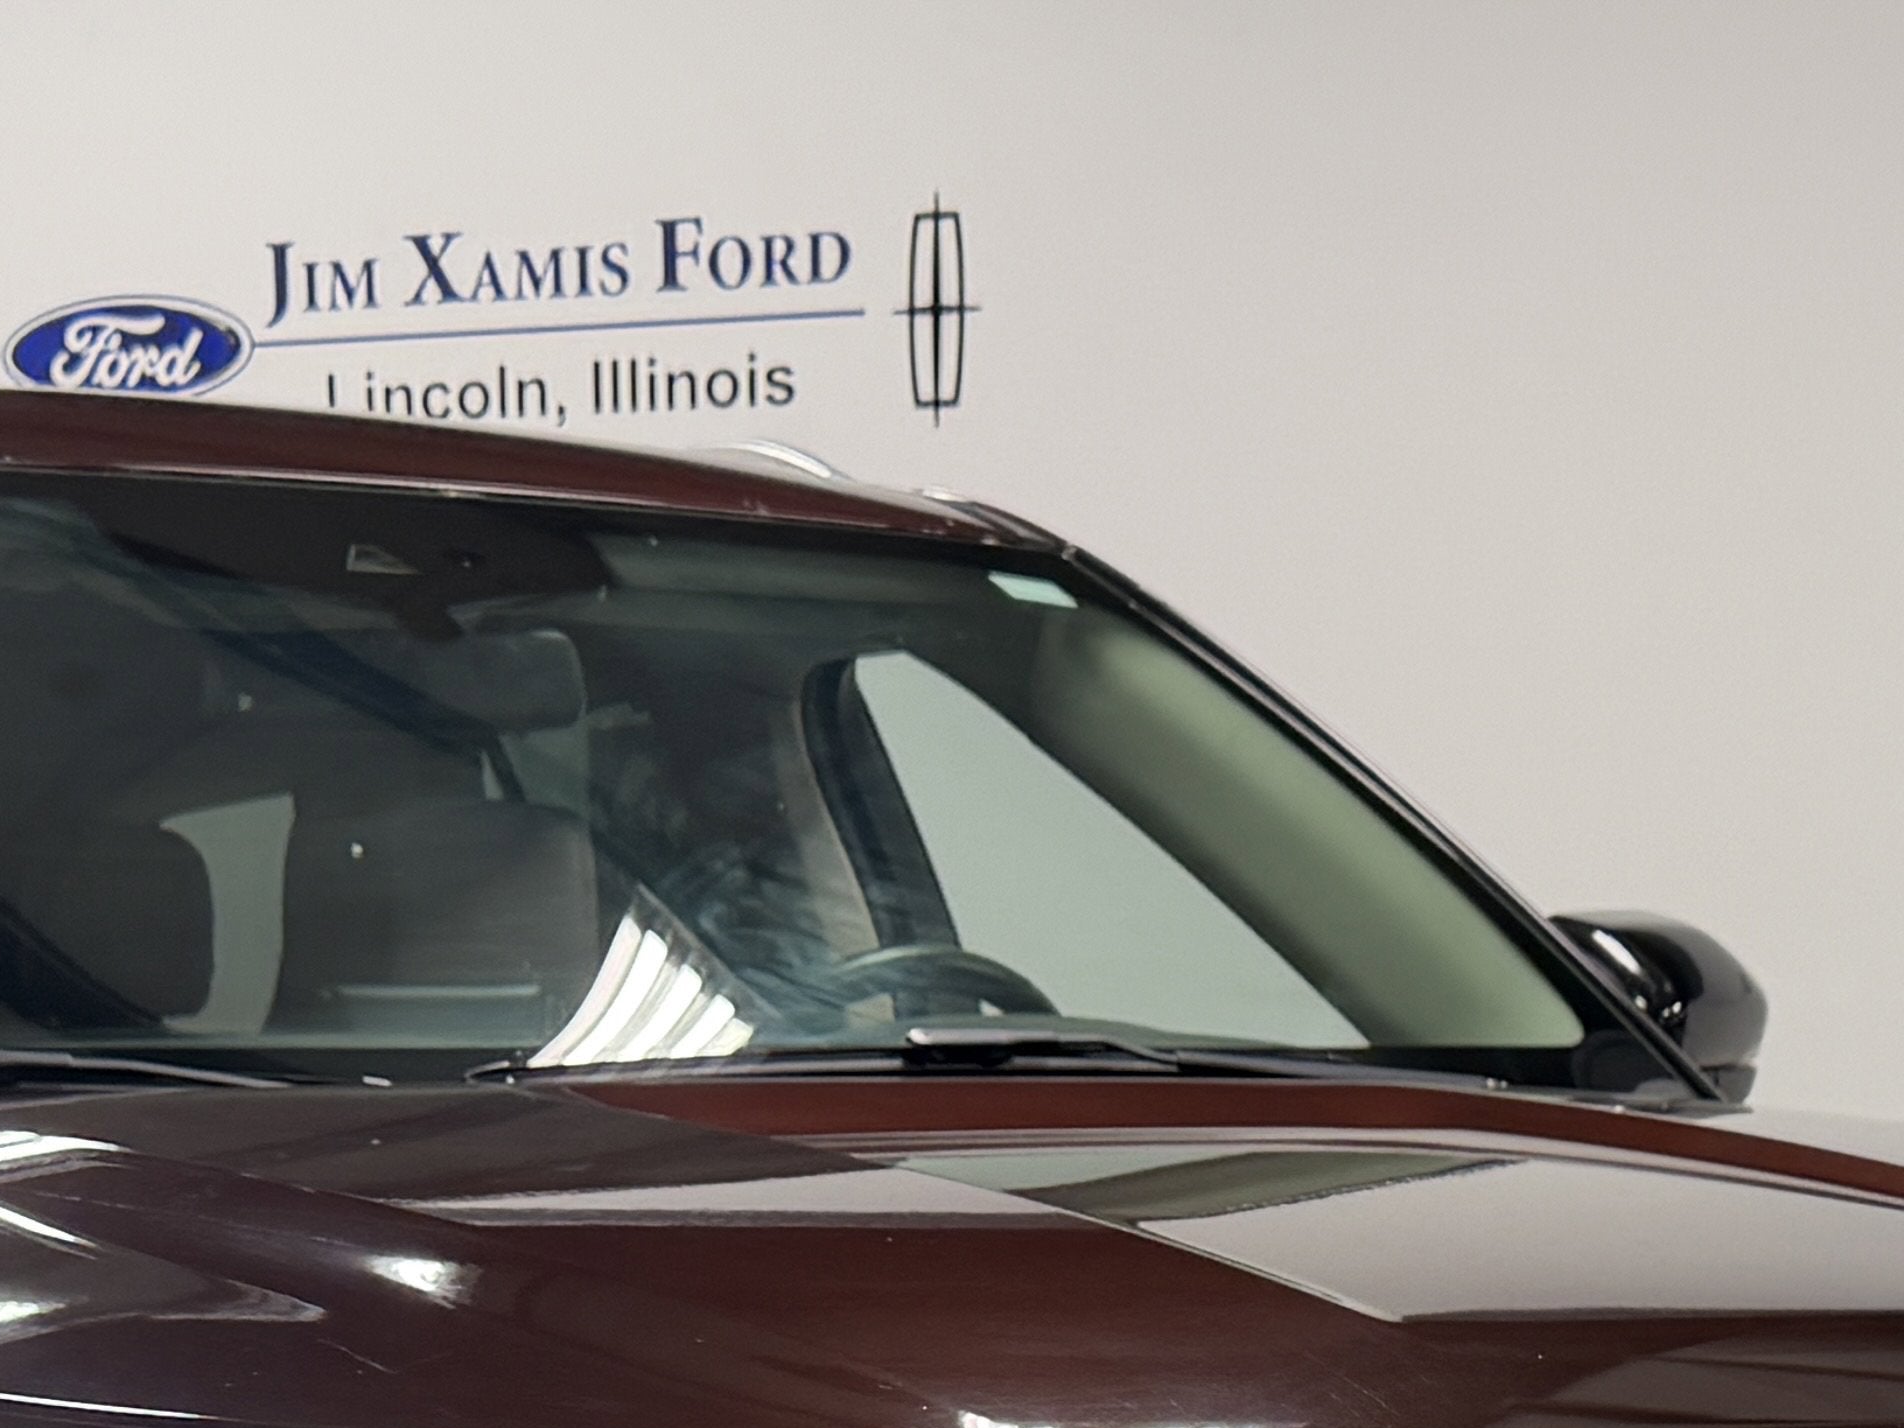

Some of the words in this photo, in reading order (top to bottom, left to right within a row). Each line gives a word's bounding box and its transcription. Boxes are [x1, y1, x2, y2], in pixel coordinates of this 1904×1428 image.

[267, 242, 377, 328] JIM
[404, 232, 629, 307] XAMIS
[656, 217, 851, 292] FORD
[50, 313, 204, 390] Ford
[593, 352, 795, 415] Illinois
